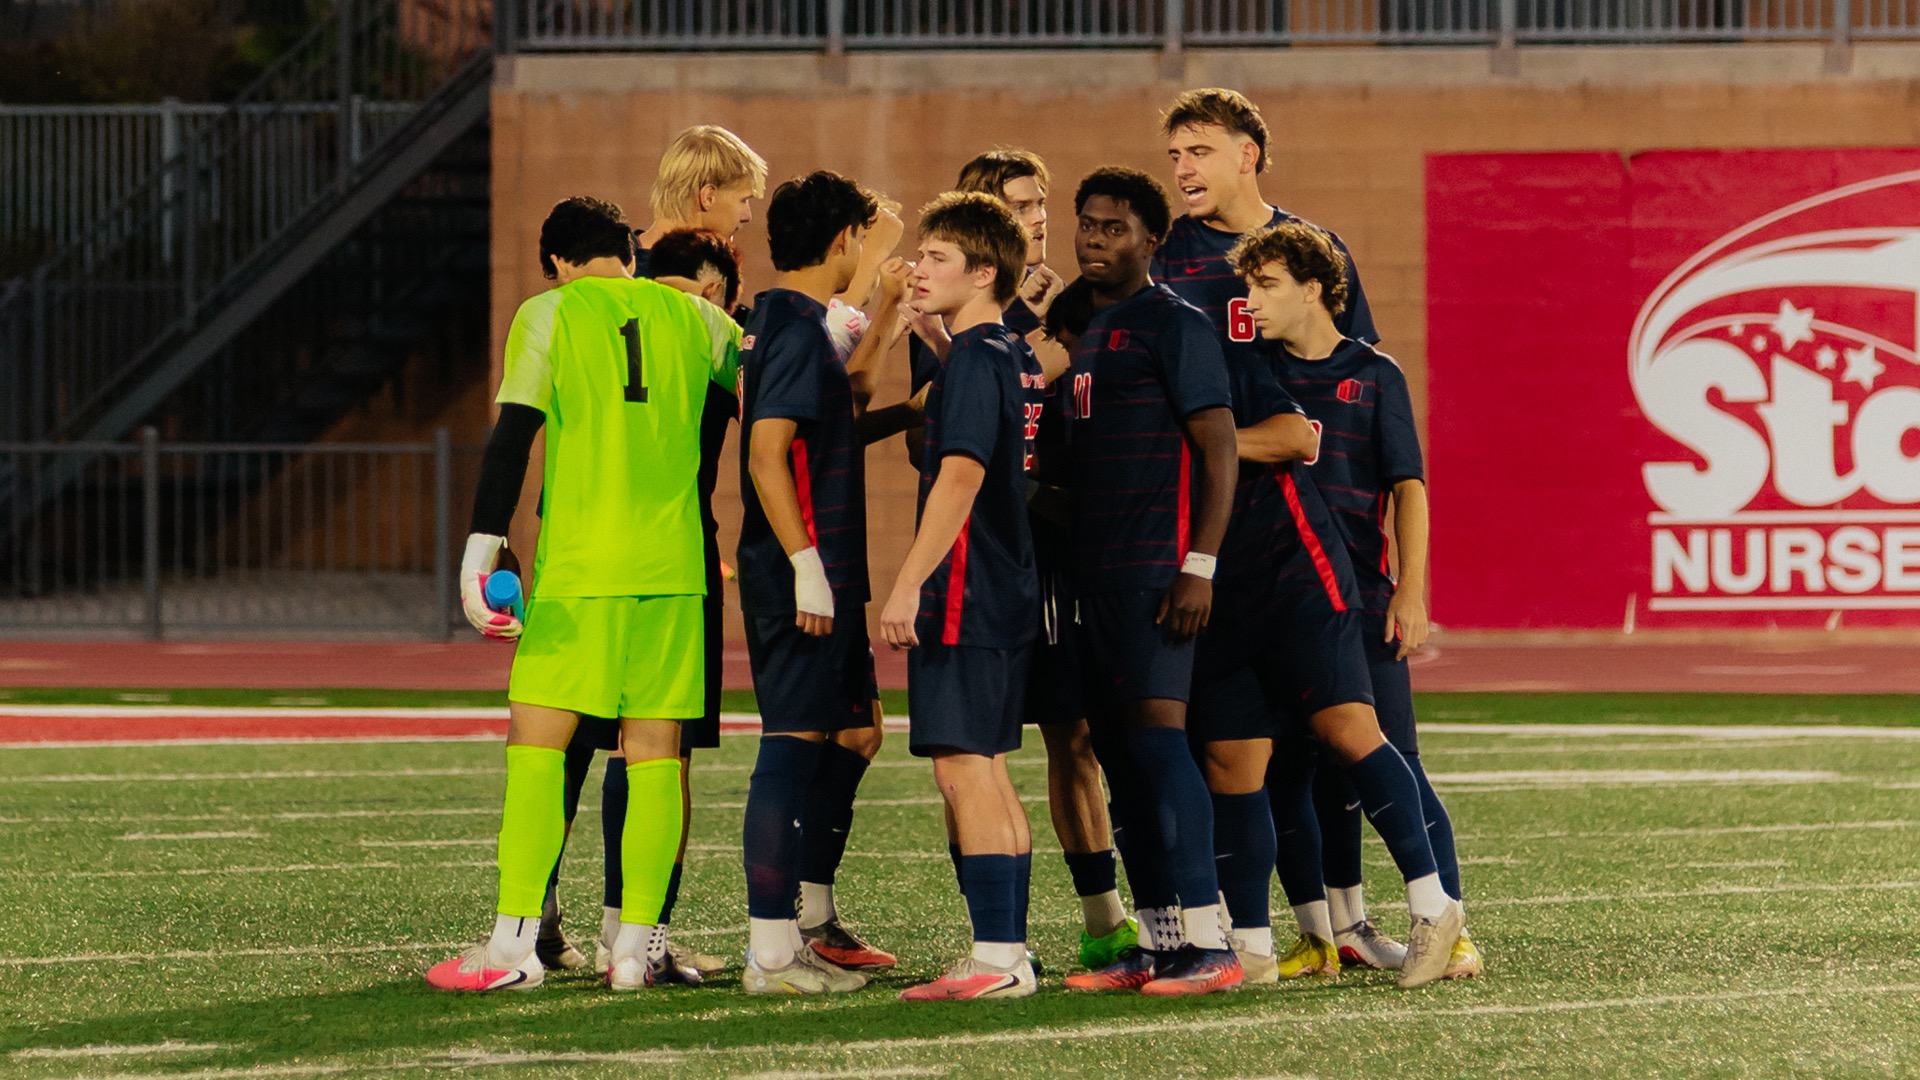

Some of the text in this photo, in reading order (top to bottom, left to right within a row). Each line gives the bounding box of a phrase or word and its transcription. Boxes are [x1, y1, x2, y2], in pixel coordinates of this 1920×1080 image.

[1228, 297, 1256, 342] 6
[619, 317, 649, 403] 1
[1652, 526, 1920, 594] NURSE
